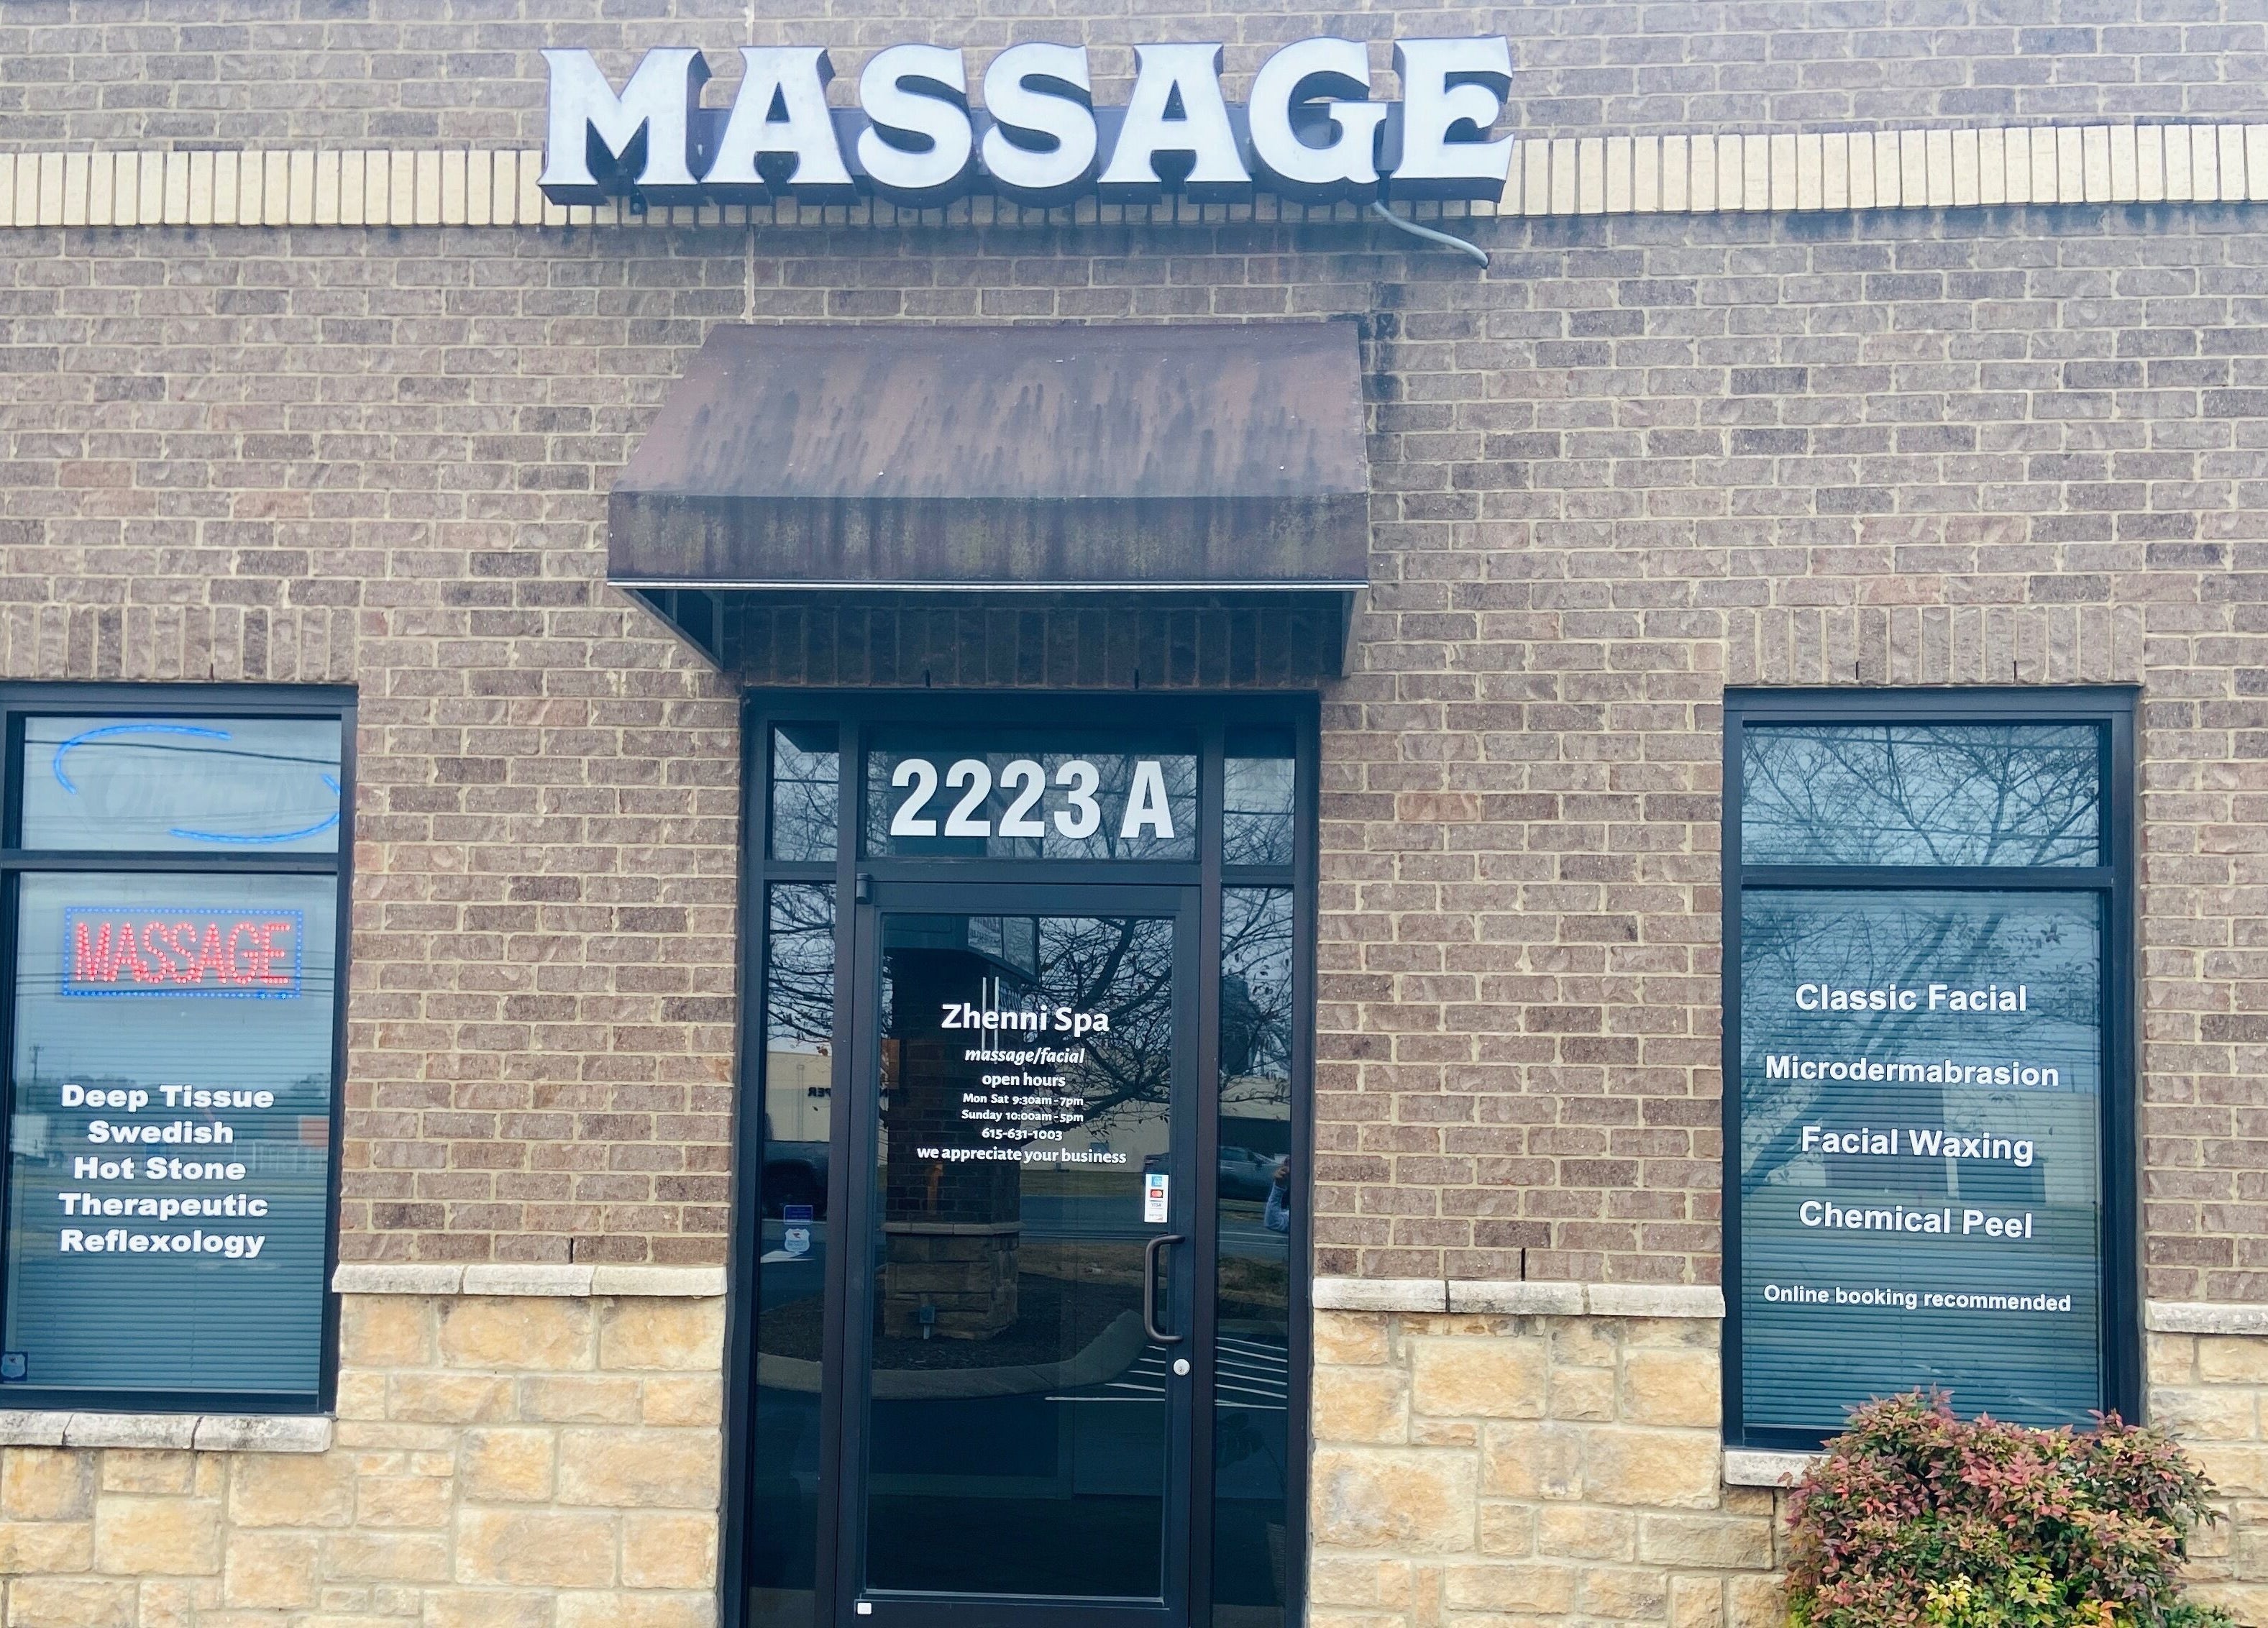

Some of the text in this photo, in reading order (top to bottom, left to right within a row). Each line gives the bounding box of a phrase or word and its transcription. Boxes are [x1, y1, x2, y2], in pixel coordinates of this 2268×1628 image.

[537, 35, 1515, 190] MASSAGE
[890, 758, 1176, 839] 2223 A
[74, 921, 291, 985] MASSAGE
[1795, 983, 2027, 1012] Classic Facial
[941, 1002, 1111, 1038] Zhenni Spa
[964, 1046, 1086, 1066] massage/facial
[982, 1071, 1066, 1089] open hours
[1765, 1054, 2059, 1087] Microdermabrasion
[61, 1084, 275, 1112] Deep Tissue
[962, 1092, 987, 1104] Mon
[990, 1094, 1010, 1105] Sat
[961, 1109, 1003, 1122] Sunday
[88, 1120, 234, 1143] Swedish
[982, 1127, 1063, 1142] 615-631-1003
[917, 1145, 1128, 1164] we appreciate your business
[1801, 1125, 2034, 1168] Facial Waxing
[73, 1156, 247, 1180] Hot Stone
[58, 1192, 269, 1221] Therapeutic
[1799, 1199, 2033, 1239] Chemical Peel
[60, 1228, 266, 1258] Reflexology
[1763, 1284, 2072, 1312] Online booking recommended
